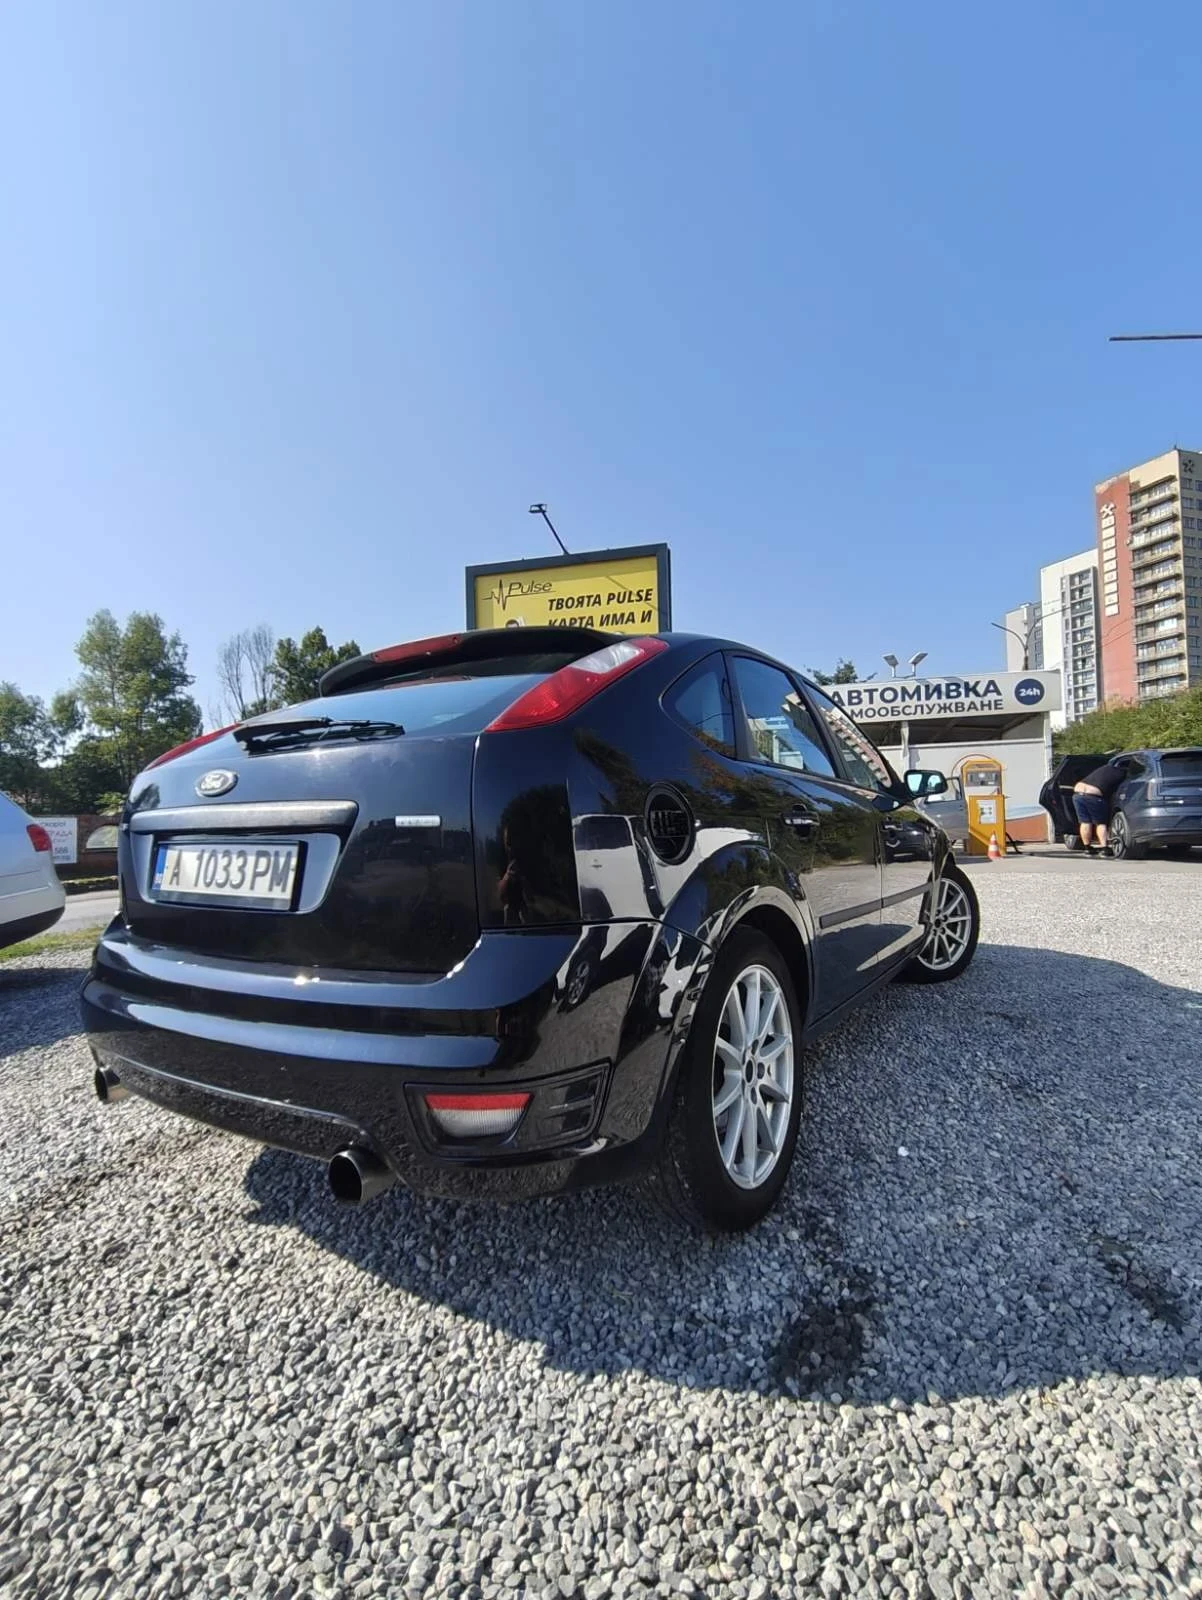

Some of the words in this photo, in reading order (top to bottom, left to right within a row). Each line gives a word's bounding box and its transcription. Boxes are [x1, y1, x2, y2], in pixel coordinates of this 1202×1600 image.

[508, 581, 552, 594] Pulse
[548, 594, 602, 611] ТВОЯТА
[606, 588, 653, 605] PULSE
[599, 612, 635, 627] ИМА
[640, 610, 652, 623] И
[831, 680, 1002, 707] АВТОМИВКА
[1019, 687, 1040, 697] 24h
[169, 849, 183, 886] A
[194, 849, 248, 889] 1033
